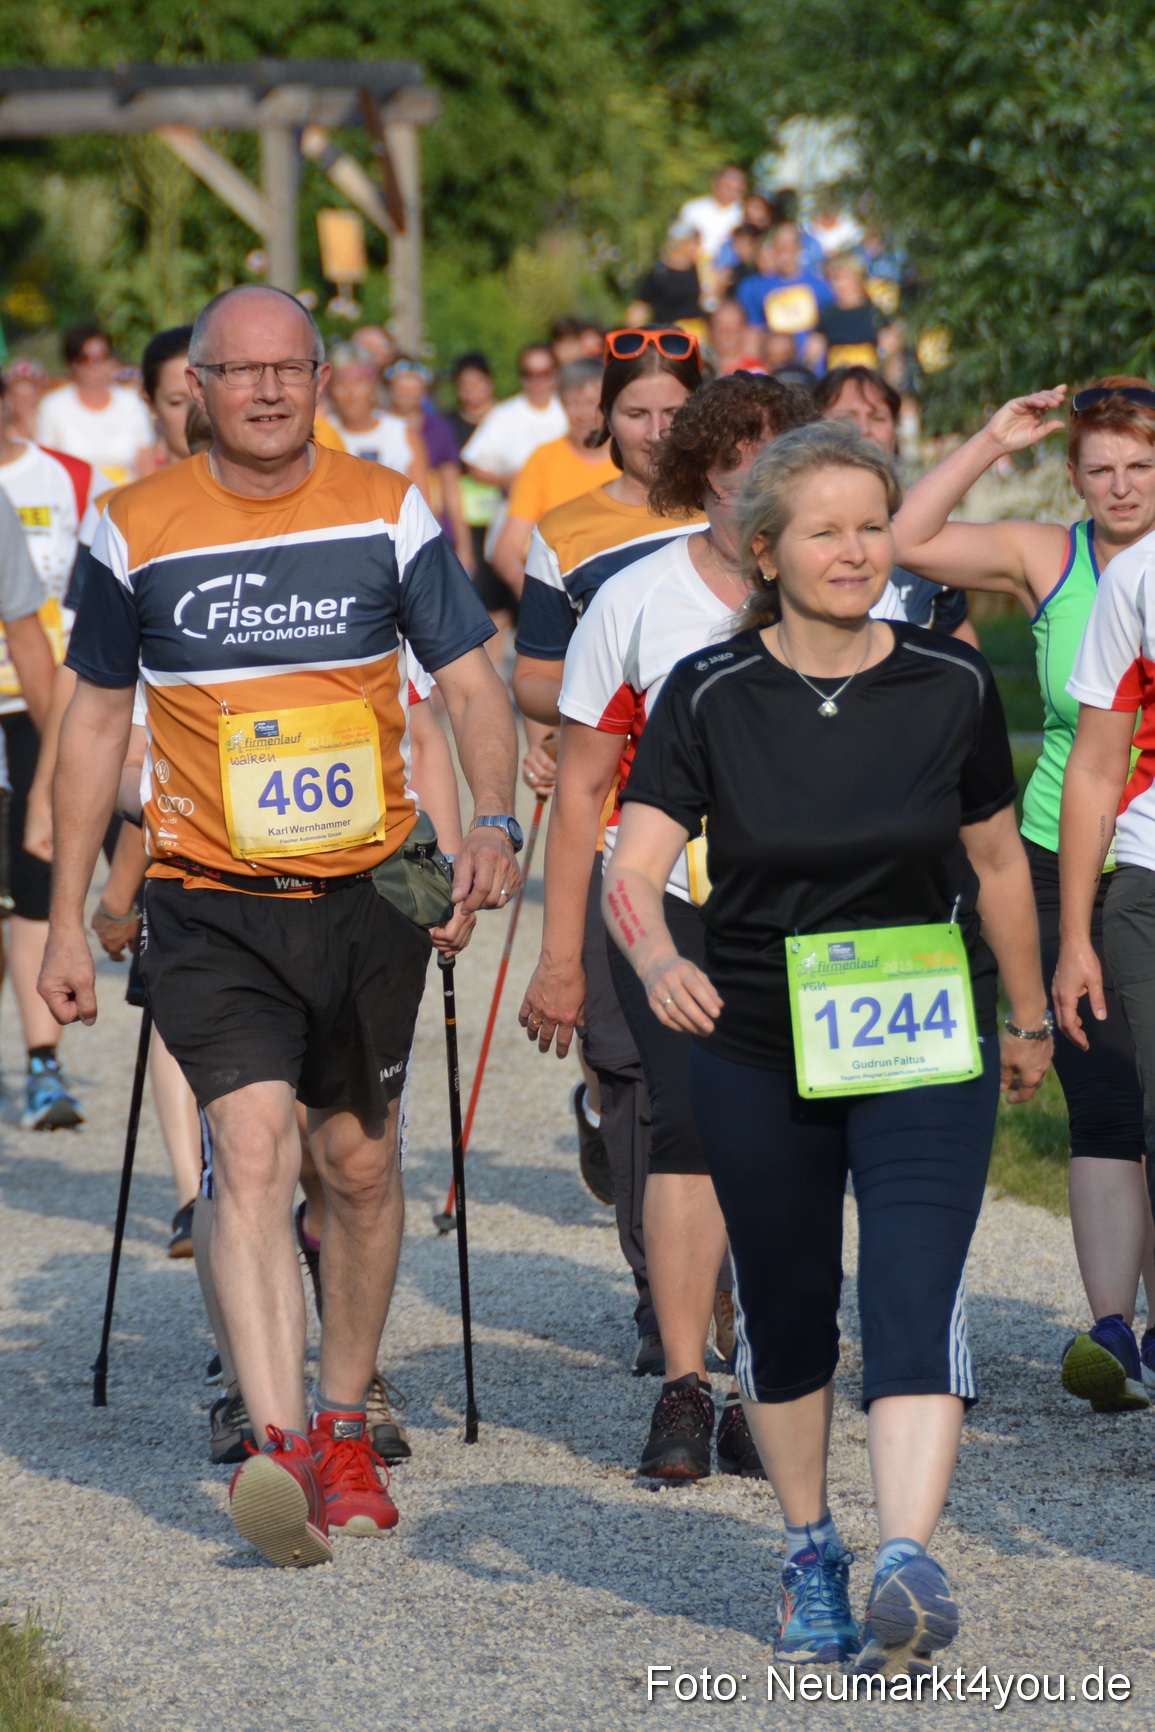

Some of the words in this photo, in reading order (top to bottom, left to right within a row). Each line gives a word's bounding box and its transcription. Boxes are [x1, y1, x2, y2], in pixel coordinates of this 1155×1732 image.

[207, 595, 356, 630] Fischer
[222, 623, 347, 645] AUTOMOBILE
[708, 652, 734, 664] JAKO
[245, 732, 302, 748] firmenlauf
[230, 753, 277, 766] walken
[257, 762, 354, 816] 466
[268, 827, 288, 836] Karl
[290, 819, 352, 834] Wernhammer
[817, 956, 880, 973] firmenlauf
[814, 989, 958, 1050] 1244
[852, 1058, 892, 1070] Gudrun
[894, 1055, 926, 1066] Faltus
